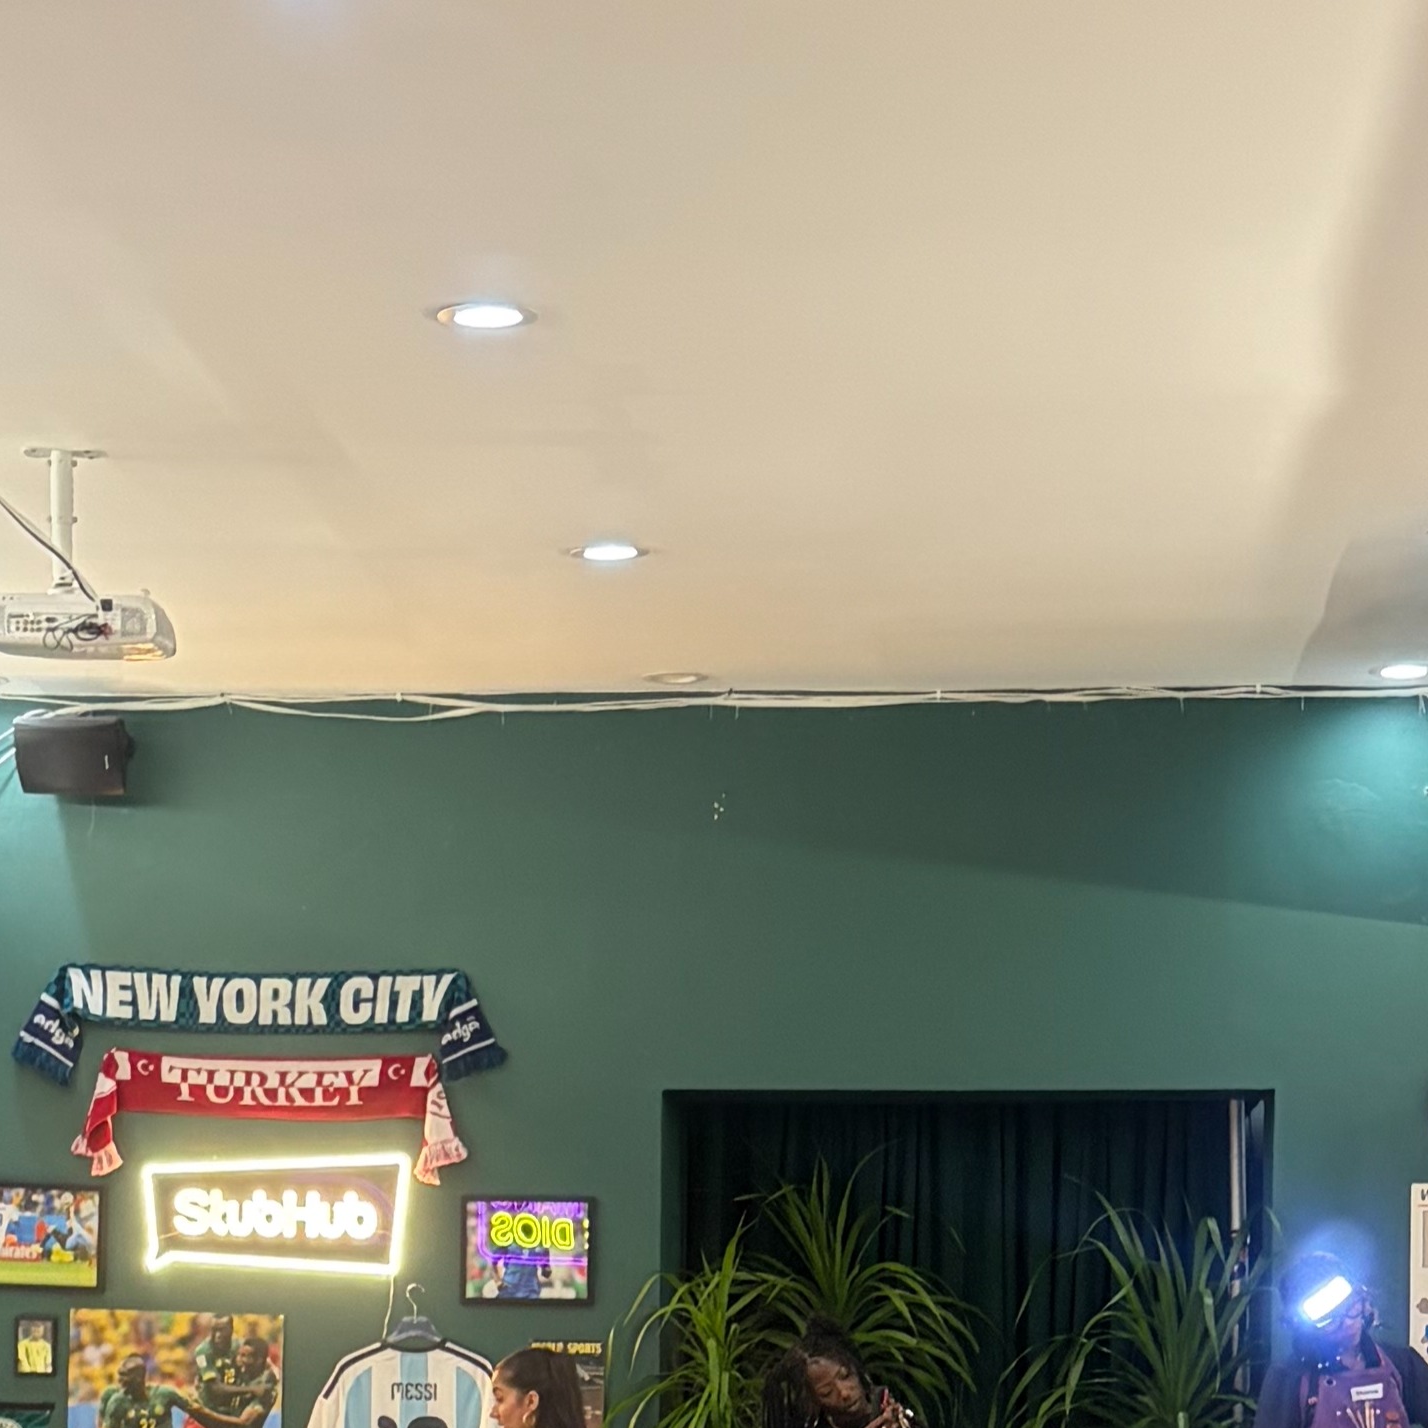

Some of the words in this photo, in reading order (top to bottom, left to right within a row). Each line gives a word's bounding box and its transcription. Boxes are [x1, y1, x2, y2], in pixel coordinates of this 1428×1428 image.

[67, 967, 182, 1023] NEW
[193, 974, 332, 1026] YORK
[340, 972, 456, 1025] CITY
[168, 1065, 370, 1107] TURKEY
[172, 1187, 377, 1240] StubHub
[567, 1342, 602, 1355] SPORTS
[391, 1382, 438, 1401] MESSI
